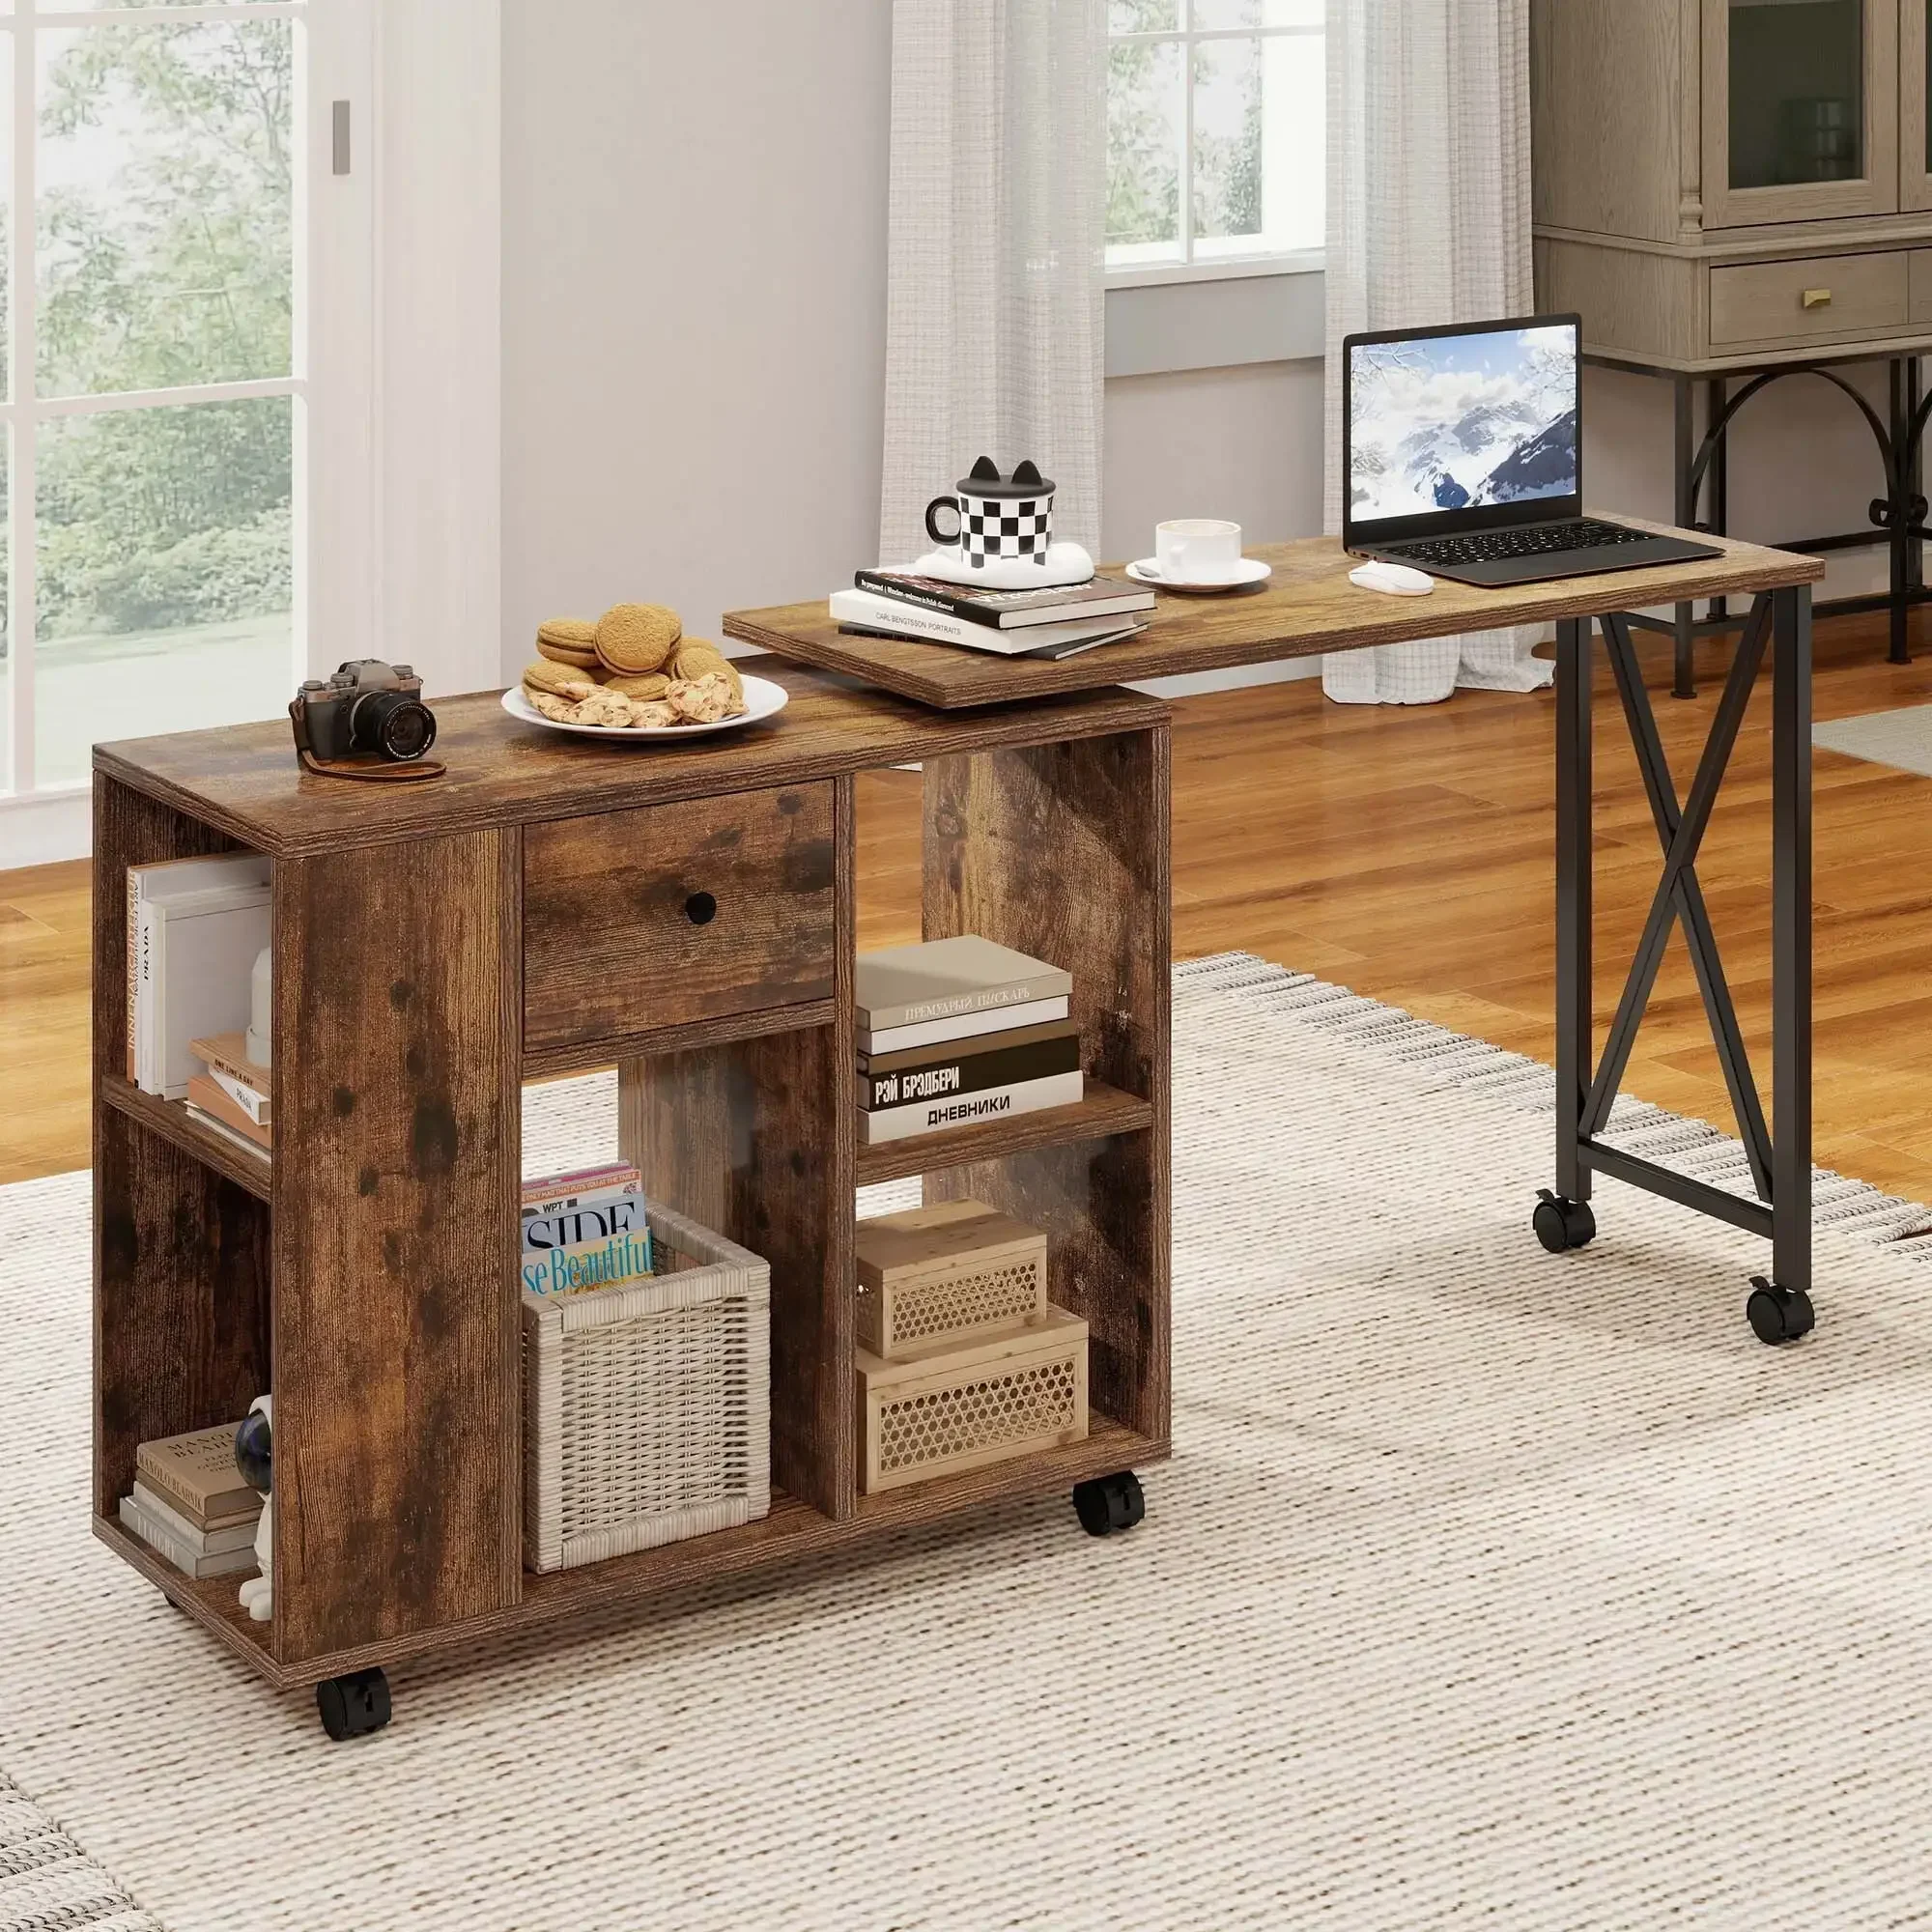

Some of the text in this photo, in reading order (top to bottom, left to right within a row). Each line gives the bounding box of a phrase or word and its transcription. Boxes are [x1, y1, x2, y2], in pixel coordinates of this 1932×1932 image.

[875, 611, 890, 622] CARL
[892, 615, 927, 631] BENGTSSON
[928, 623, 961, 636] PORTRAITS
[904, 986, 1031, 1022] ПРЕМУДРЫЙ ПИСКАРЬ
[875, 1065, 960, 1105] РЭЙ БРЭДБЕРИ
[927, 1094, 1010, 1126] ДНЕВНИКИ
[543, 1200, 563, 1213] WPT
[523, 1201, 636, 1249] SIDE
[523, 1226, 654, 1297] se Beautiful
[138, 1451, 171, 1488] MANOLO
